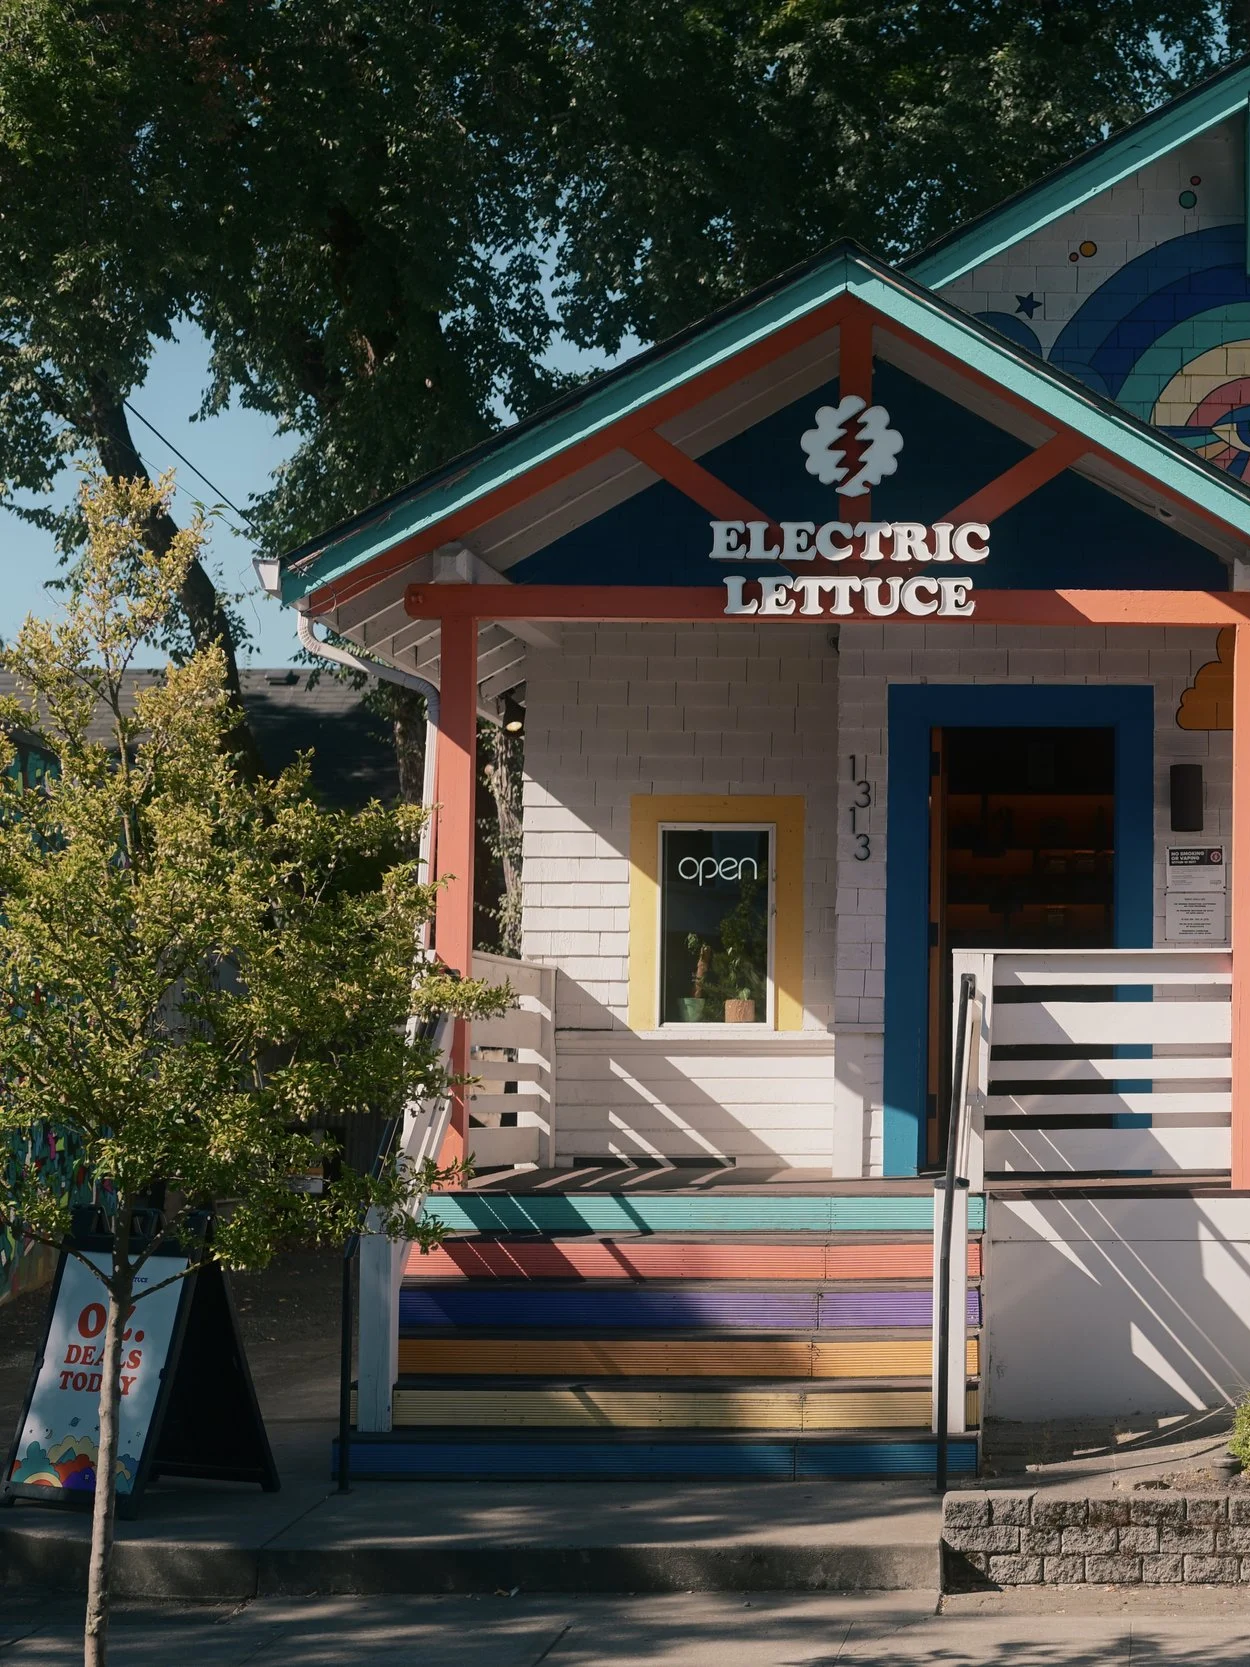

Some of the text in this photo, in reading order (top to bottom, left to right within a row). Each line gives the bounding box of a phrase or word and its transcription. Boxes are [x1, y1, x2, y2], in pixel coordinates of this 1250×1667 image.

[709, 520, 990, 562] ELECTRIC
[723, 575, 976, 616] LETTUCE
[848, 754, 871, 861] 1313
[678, 856, 758, 887] open
[59, 1370, 137, 1396] TODY
